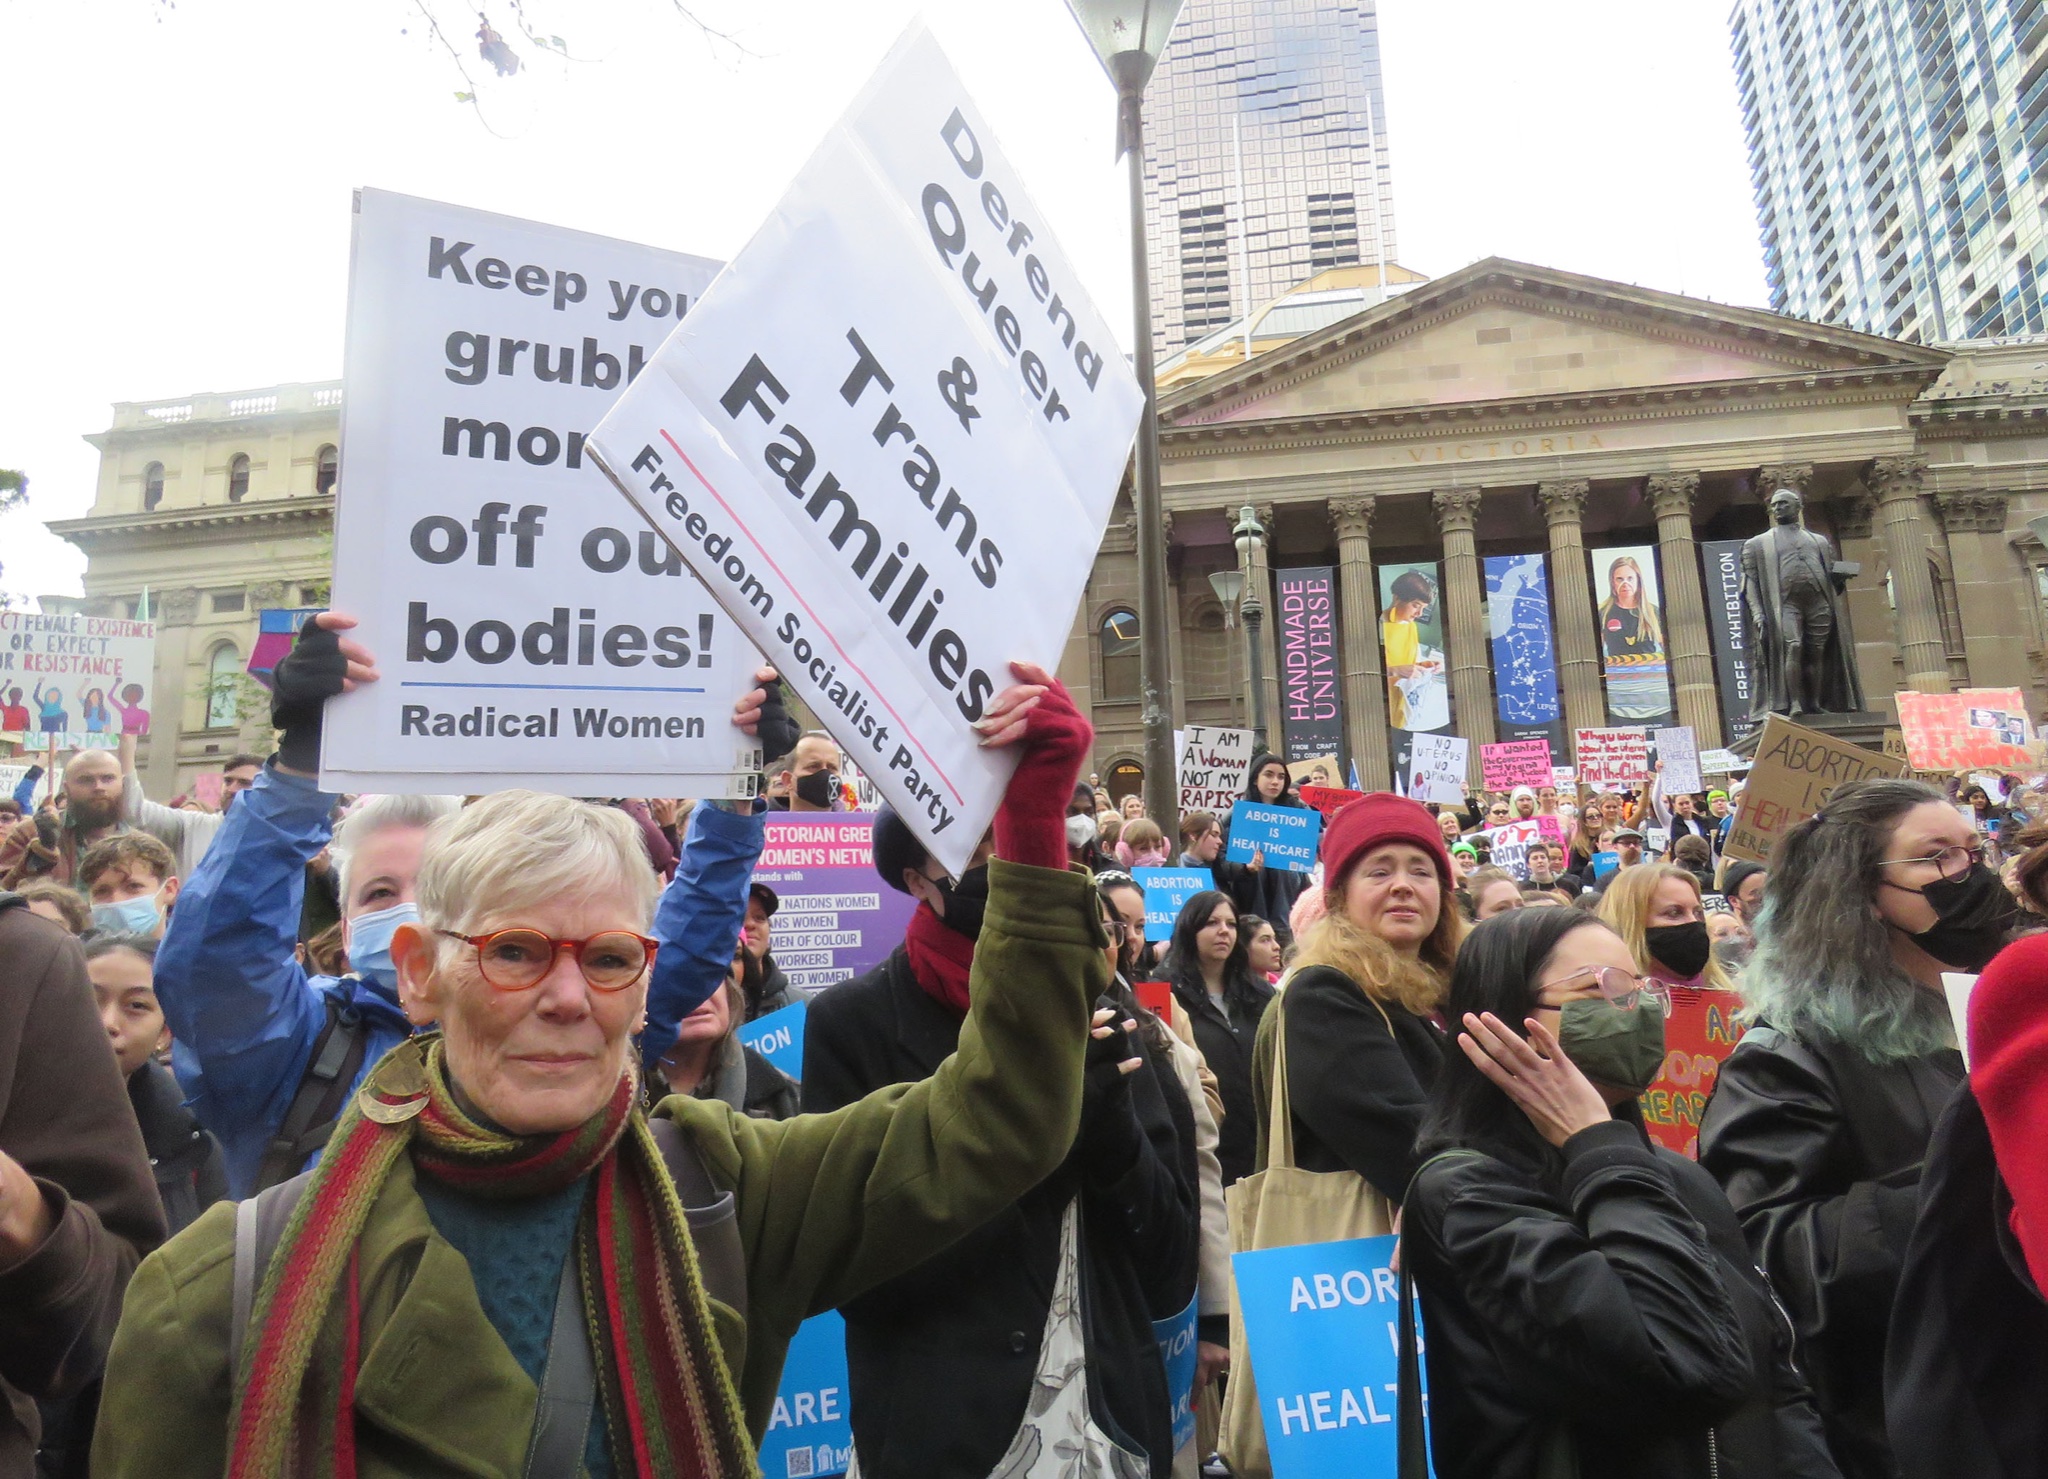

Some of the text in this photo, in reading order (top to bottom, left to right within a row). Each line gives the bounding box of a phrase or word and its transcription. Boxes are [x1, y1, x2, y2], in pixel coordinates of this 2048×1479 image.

[940, 105, 1104, 393] Defend
[428, 236, 588, 311] Keep
[921, 182, 1070, 425] Queer
[937, 355, 981, 434] &
[839, 327, 1004, 588] Trans
[1408, 434, 1604, 462] VICTORIA
[410, 502, 547, 568] off
[719, 353, 994, 724] Families
[1719, 552, 1743, 650] EXHIBITION
[25, 615, 79, 634] FEMALE
[87, 618, 154, 638] EXISTENCE
[405, 601, 714, 668] bodies!
[11, 633, 111, 655] OR EXPECT
[631, 444, 955, 836] Freedom Socialist Party
[1283, 580, 1311, 721] HANDMADE
[1307, 579, 1336, 721] UNIVERSE
[23, 653, 123, 677] RESISTANCE
[401, 704, 705, 739] Radical Women
[1189, 727, 1240, 747] I AM
[1434, 738, 1451, 749] NO
[1182, 746, 1195, 765] A
[1417, 747, 1462, 761] UTERUS
[1424, 770, 1460, 784] OPINION
[1434, 761, 1448, 771] NO
[1181, 770, 1240, 788] NOT MY
[1245, 810, 1307, 827] ABORTION
[1269, 828, 1280, 838] IS
[751, 870, 803, 882] stands with
[1146, 877, 1204, 889] ABORTION
[785, 896, 875, 910] NATIONS WOMEN
[1172, 894, 1182, 905] IS
[792, 916, 834, 928] WOMEN
[797, 935, 811, 947] OF
[814, 934, 857, 946] COLOUR
[776, 953, 829, 967] WORKERS
